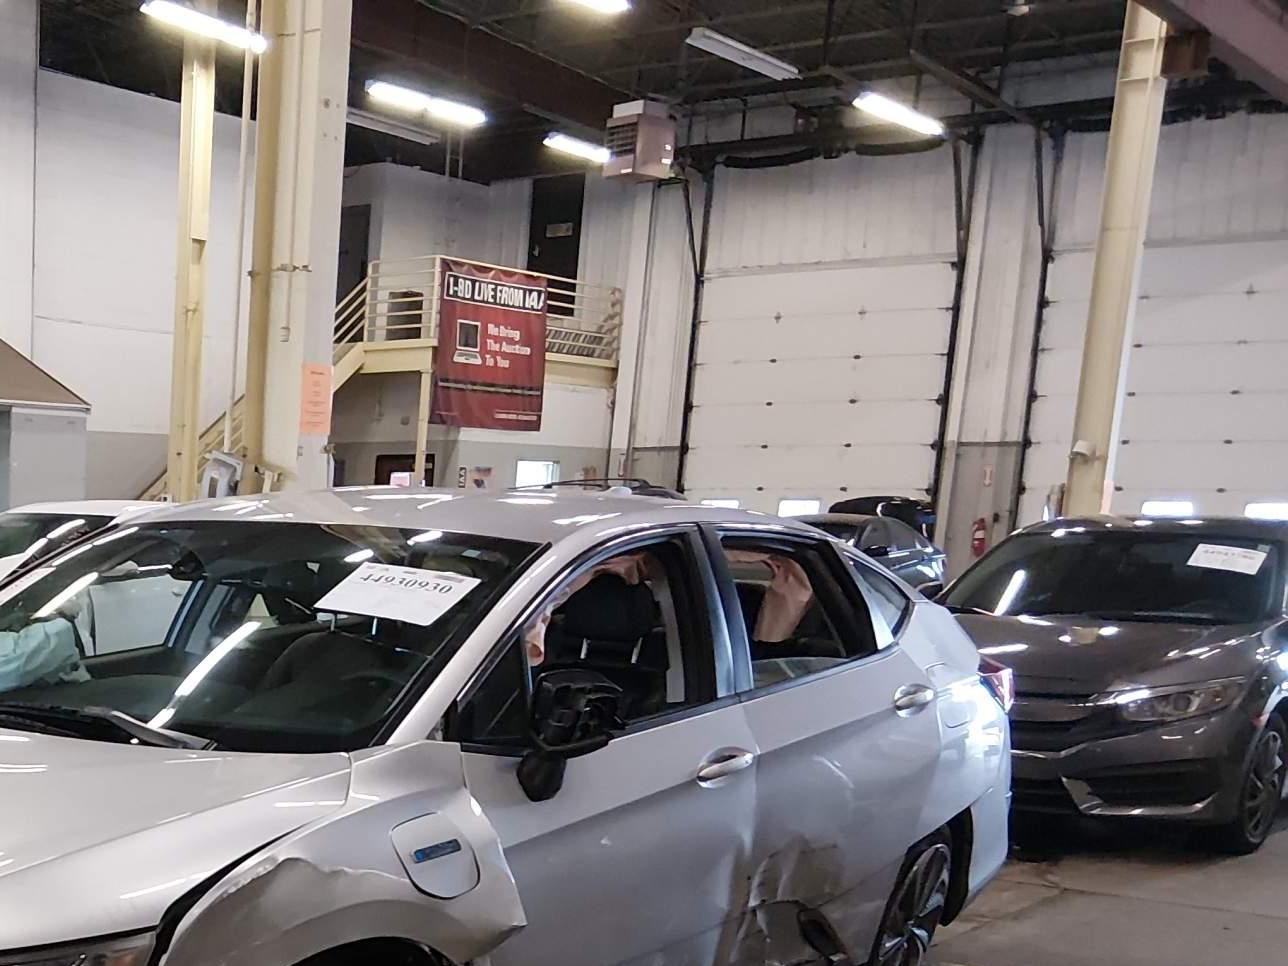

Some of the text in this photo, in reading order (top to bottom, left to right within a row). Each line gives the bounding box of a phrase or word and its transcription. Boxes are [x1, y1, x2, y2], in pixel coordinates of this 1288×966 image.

[474, 281, 496, 303] LIVE
[496, 285, 524, 307] FROM
[359, 573, 453, 594] 44930930
